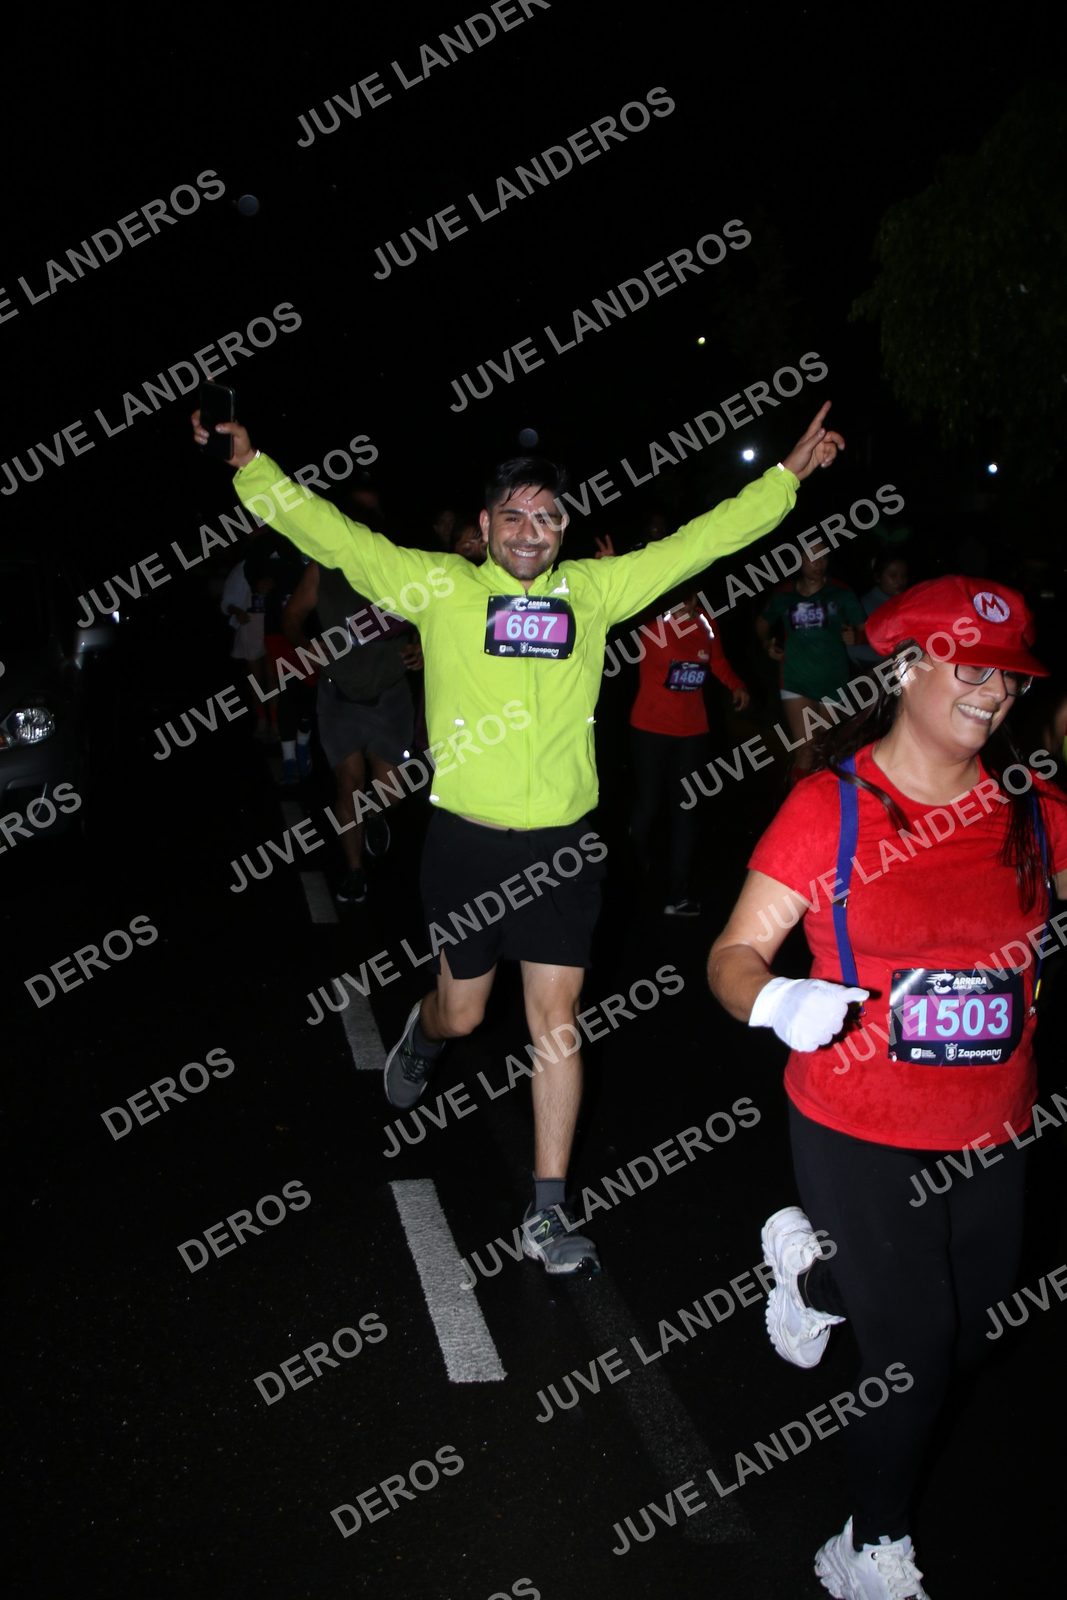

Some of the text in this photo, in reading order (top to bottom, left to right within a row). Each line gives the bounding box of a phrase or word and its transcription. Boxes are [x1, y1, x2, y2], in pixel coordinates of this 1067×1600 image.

[981, 595, 1005, 616] M
[506, 614, 558, 640] 667
[673, 670, 705, 684] 1468
[910, 996, 1009, 1037] 1503
